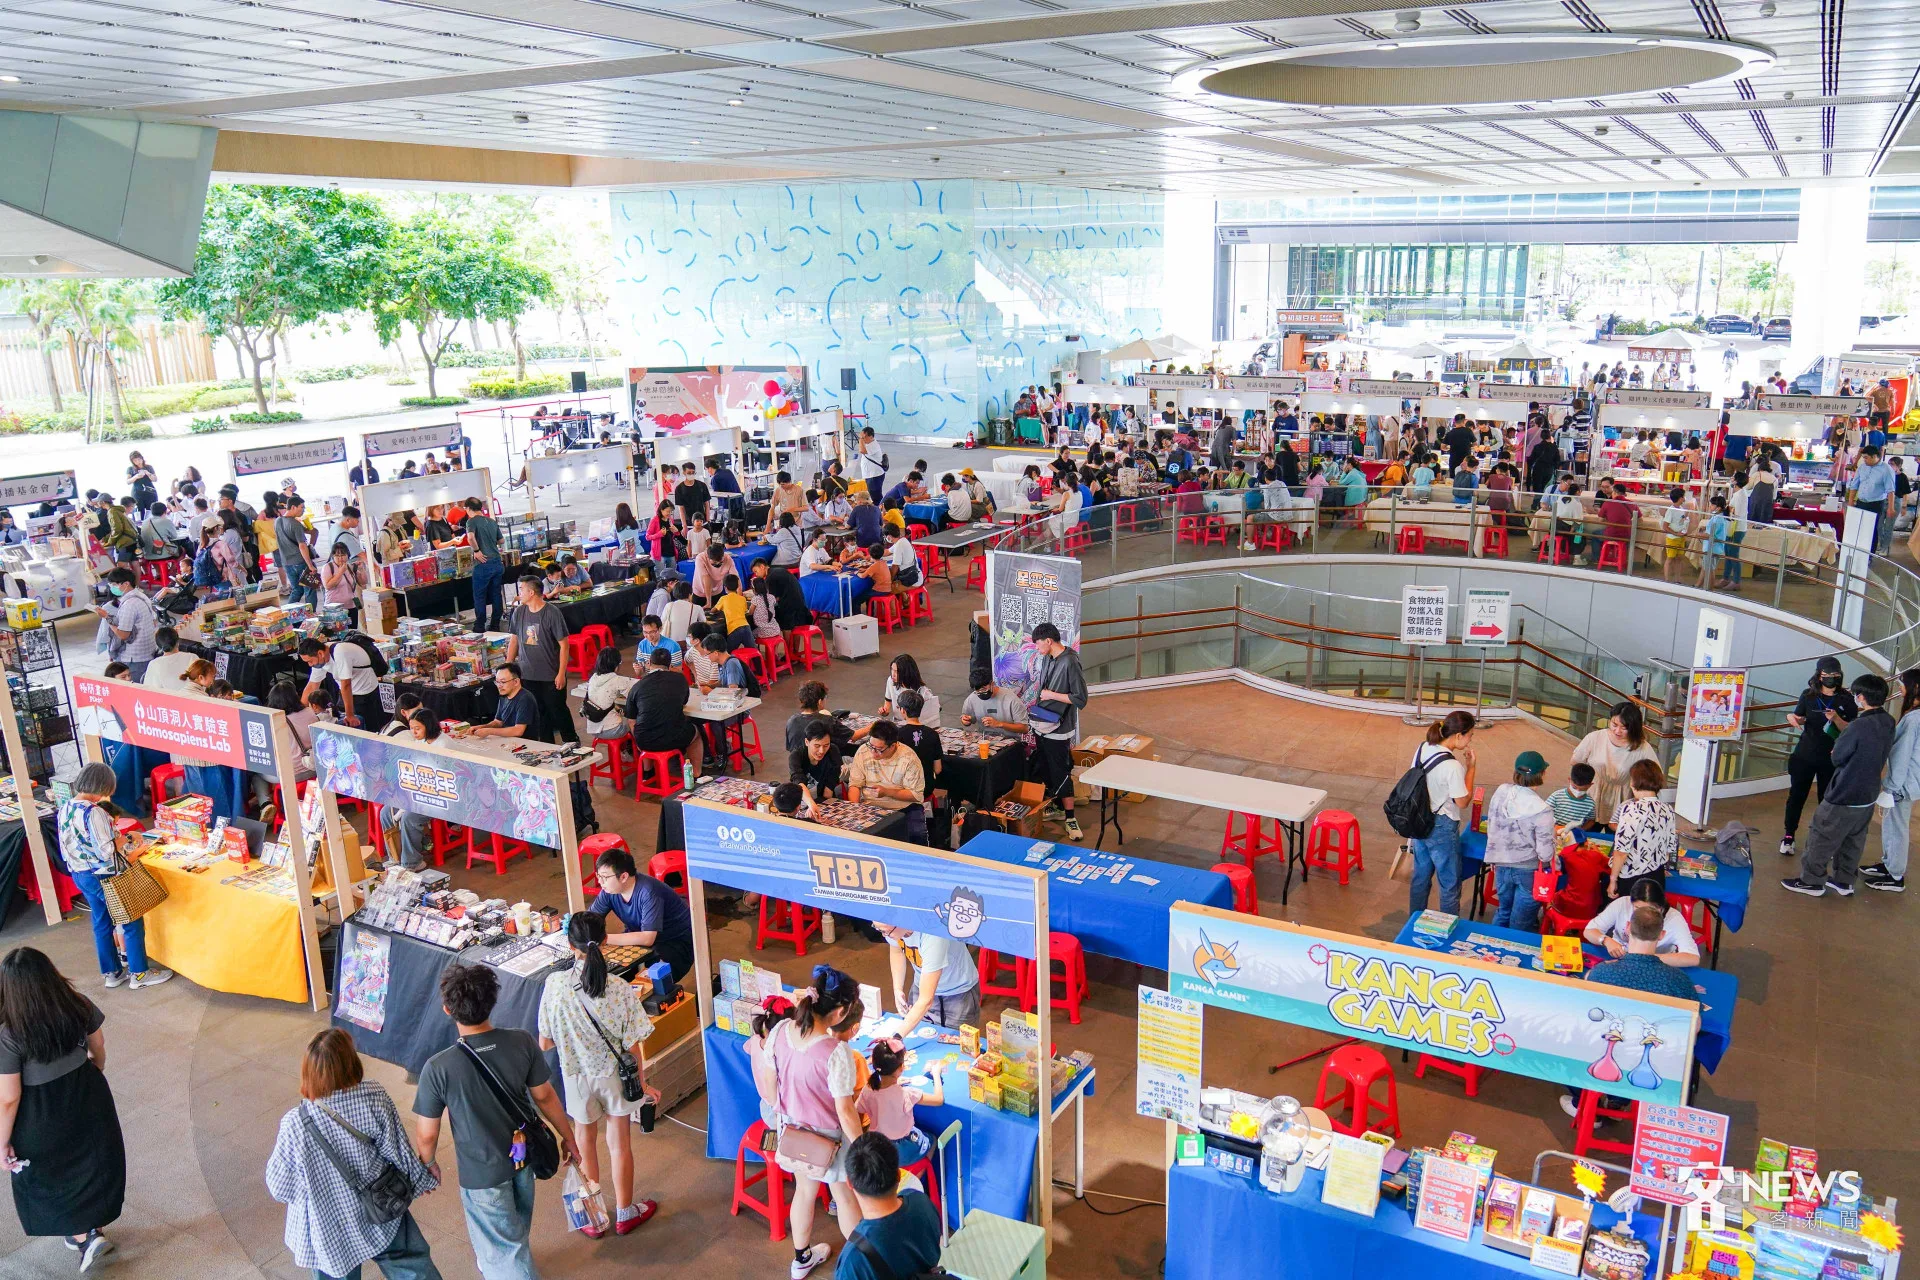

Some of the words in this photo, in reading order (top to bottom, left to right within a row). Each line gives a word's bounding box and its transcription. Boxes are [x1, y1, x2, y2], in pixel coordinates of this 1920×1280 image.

[0, 483, 49, 499] 播基金會
[1408, 595, 1444, 605] 食物飲料
[1408, 606, 1444, 616] 勿攜入館
[1478, 605, 1497, 614] 入口
[1407, 616, 1443, 626] 敬請配合
[1406, 626, 1443, 636] 感謝合作
[1706, 627, 1719, 640] B1
[146, 703, 229, 737] 山頂洞人實驗室
[136, 719, 209, 746] Homosapiens
[209, 738, 231, 753] Lab
[398, 759, 459, 802] 星靈王
[719, 841, 781, 856] @taiwanbgdesign
[809, 851, 887, 893] TBD
[814, 888, 835, 896] TAIWAN
[835, 890, 869, 901] BOARDGAME
[869, 895, 890, 903] DESIGN
[1182, 980, 1215, 995] KANGA
[1216, 988, 1247, 1002] GAMES
[1328, 952, 1502, 1021] KANGA
[1328, 991, 1491, 1055] GAMES
[1594, 1243, 1640, 1261] KANGA
